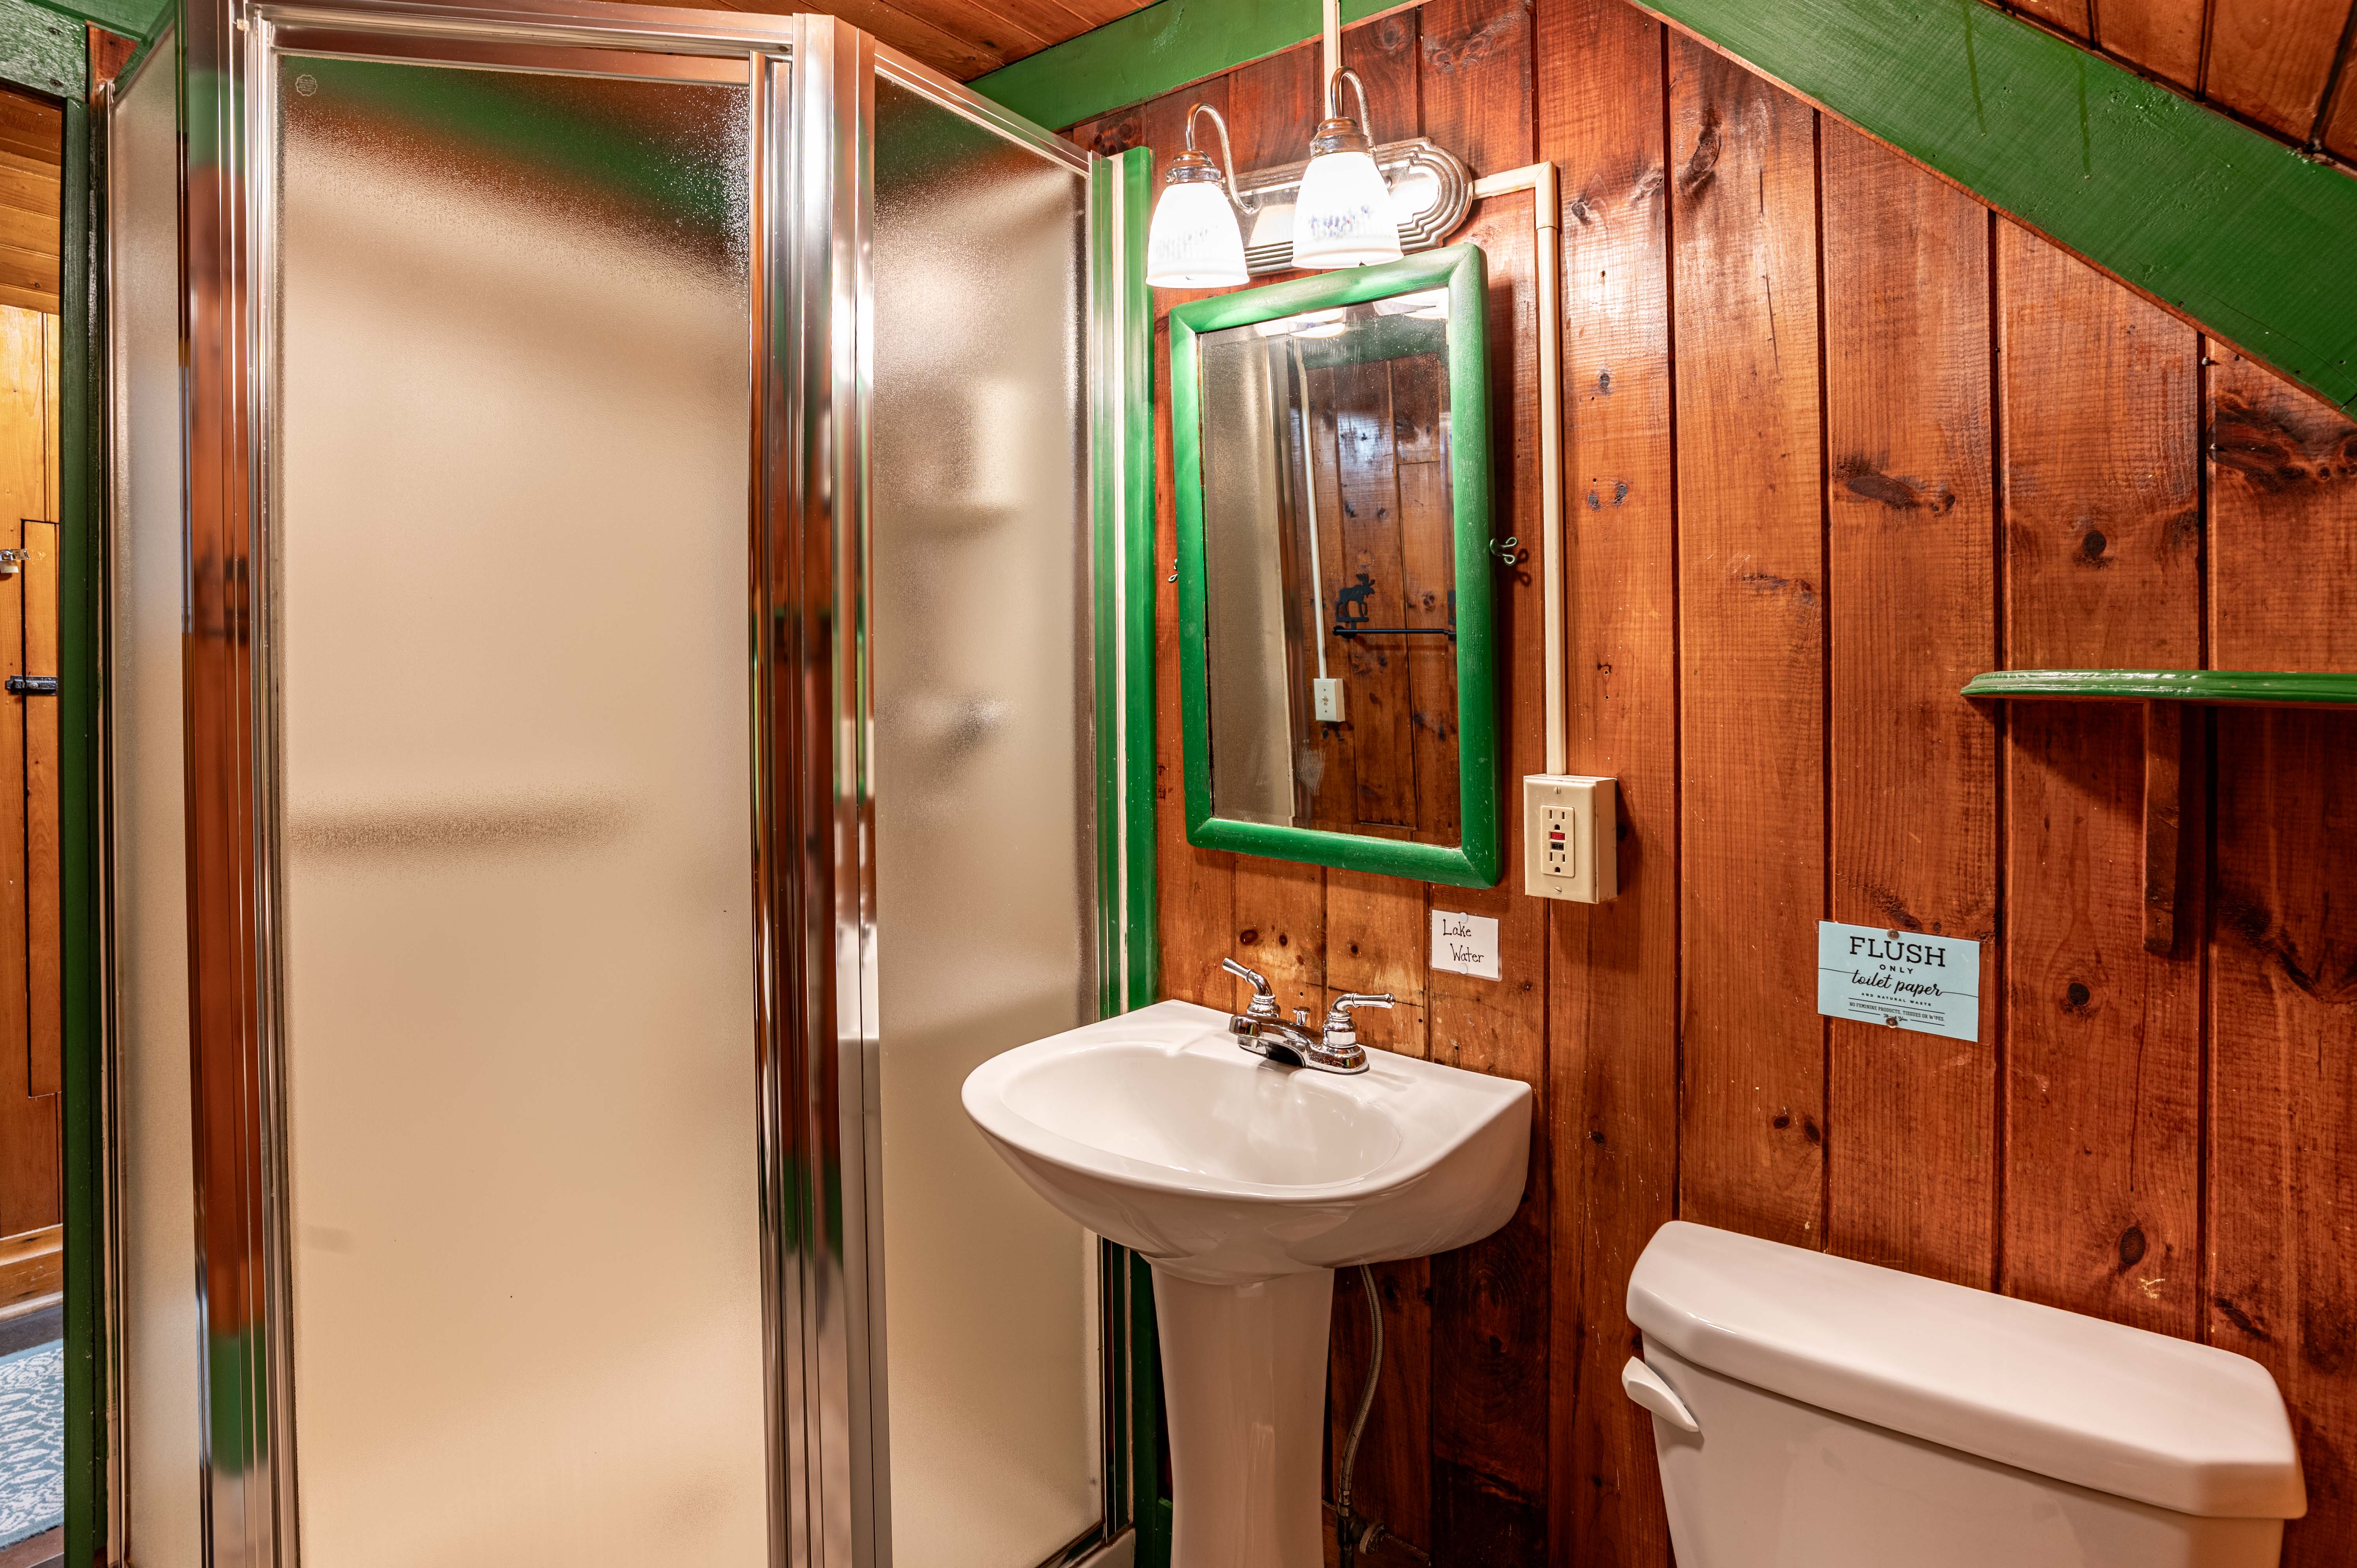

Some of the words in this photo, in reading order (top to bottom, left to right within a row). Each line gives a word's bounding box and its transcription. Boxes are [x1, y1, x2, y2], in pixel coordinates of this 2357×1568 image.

[1443, 919, 1471, 937] Lake
[1450, 943, 1484, 963] Water
[1850, 936, 1945, 967] FLUSH
[1880, 964, 1913, 974] ONLY
[1851, 969, 1892, 988] toilet
[1893, 981, 1943, 997] paper
